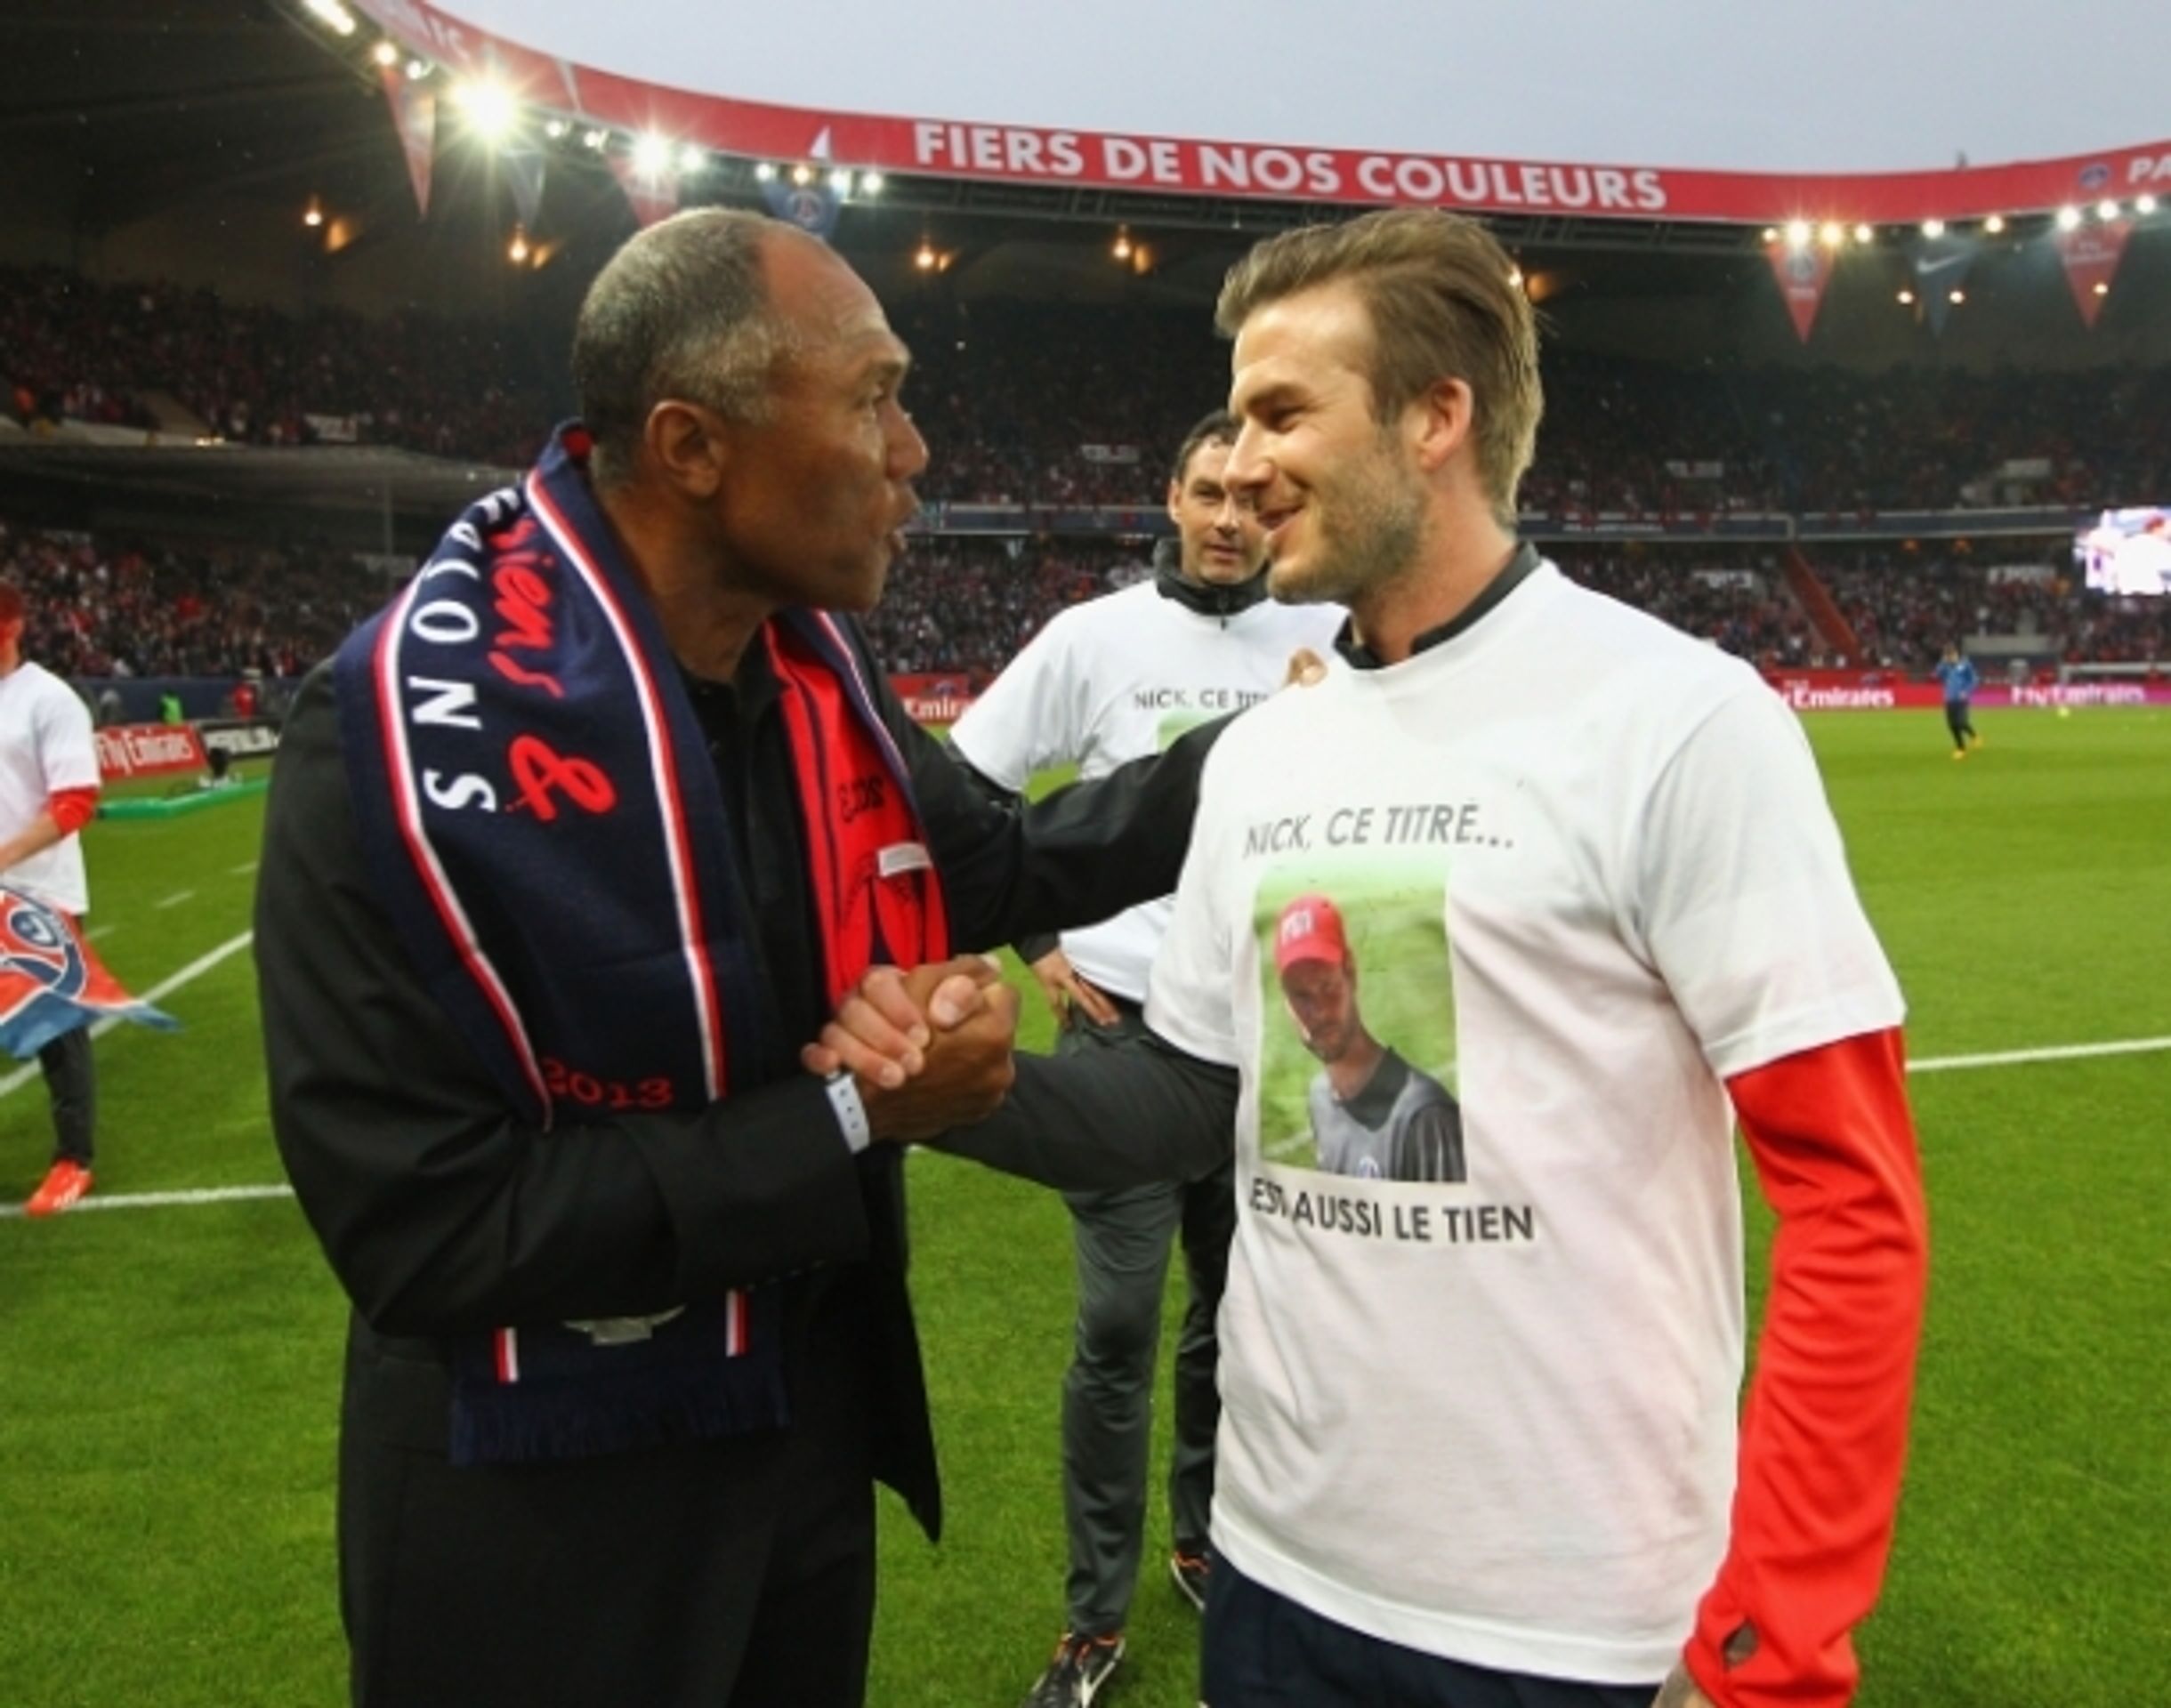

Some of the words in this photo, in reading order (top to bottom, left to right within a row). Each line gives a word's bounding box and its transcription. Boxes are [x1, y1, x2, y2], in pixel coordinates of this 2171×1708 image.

[914, 121, 1084, 178] FIERS
[1102, 139, 1183, 182] DE
[1199, 144, 1341, 194] NOS
[1357, 156, 1667, 210] COULEURS
[2127, 153, 2171, 184] PA
[1199, 689, 1229, 709] CE
[1327, 807, 1375, 847] CE
[542, 1058, 674, 1108] 2013
[1249, 1177, 1287, 1217] EST
[1292, 1190, 1383, 1237] AUSSI
[1393, 1204, 1433, 1242] LE
[1441, 1204, 1535, 1244] TIEN
